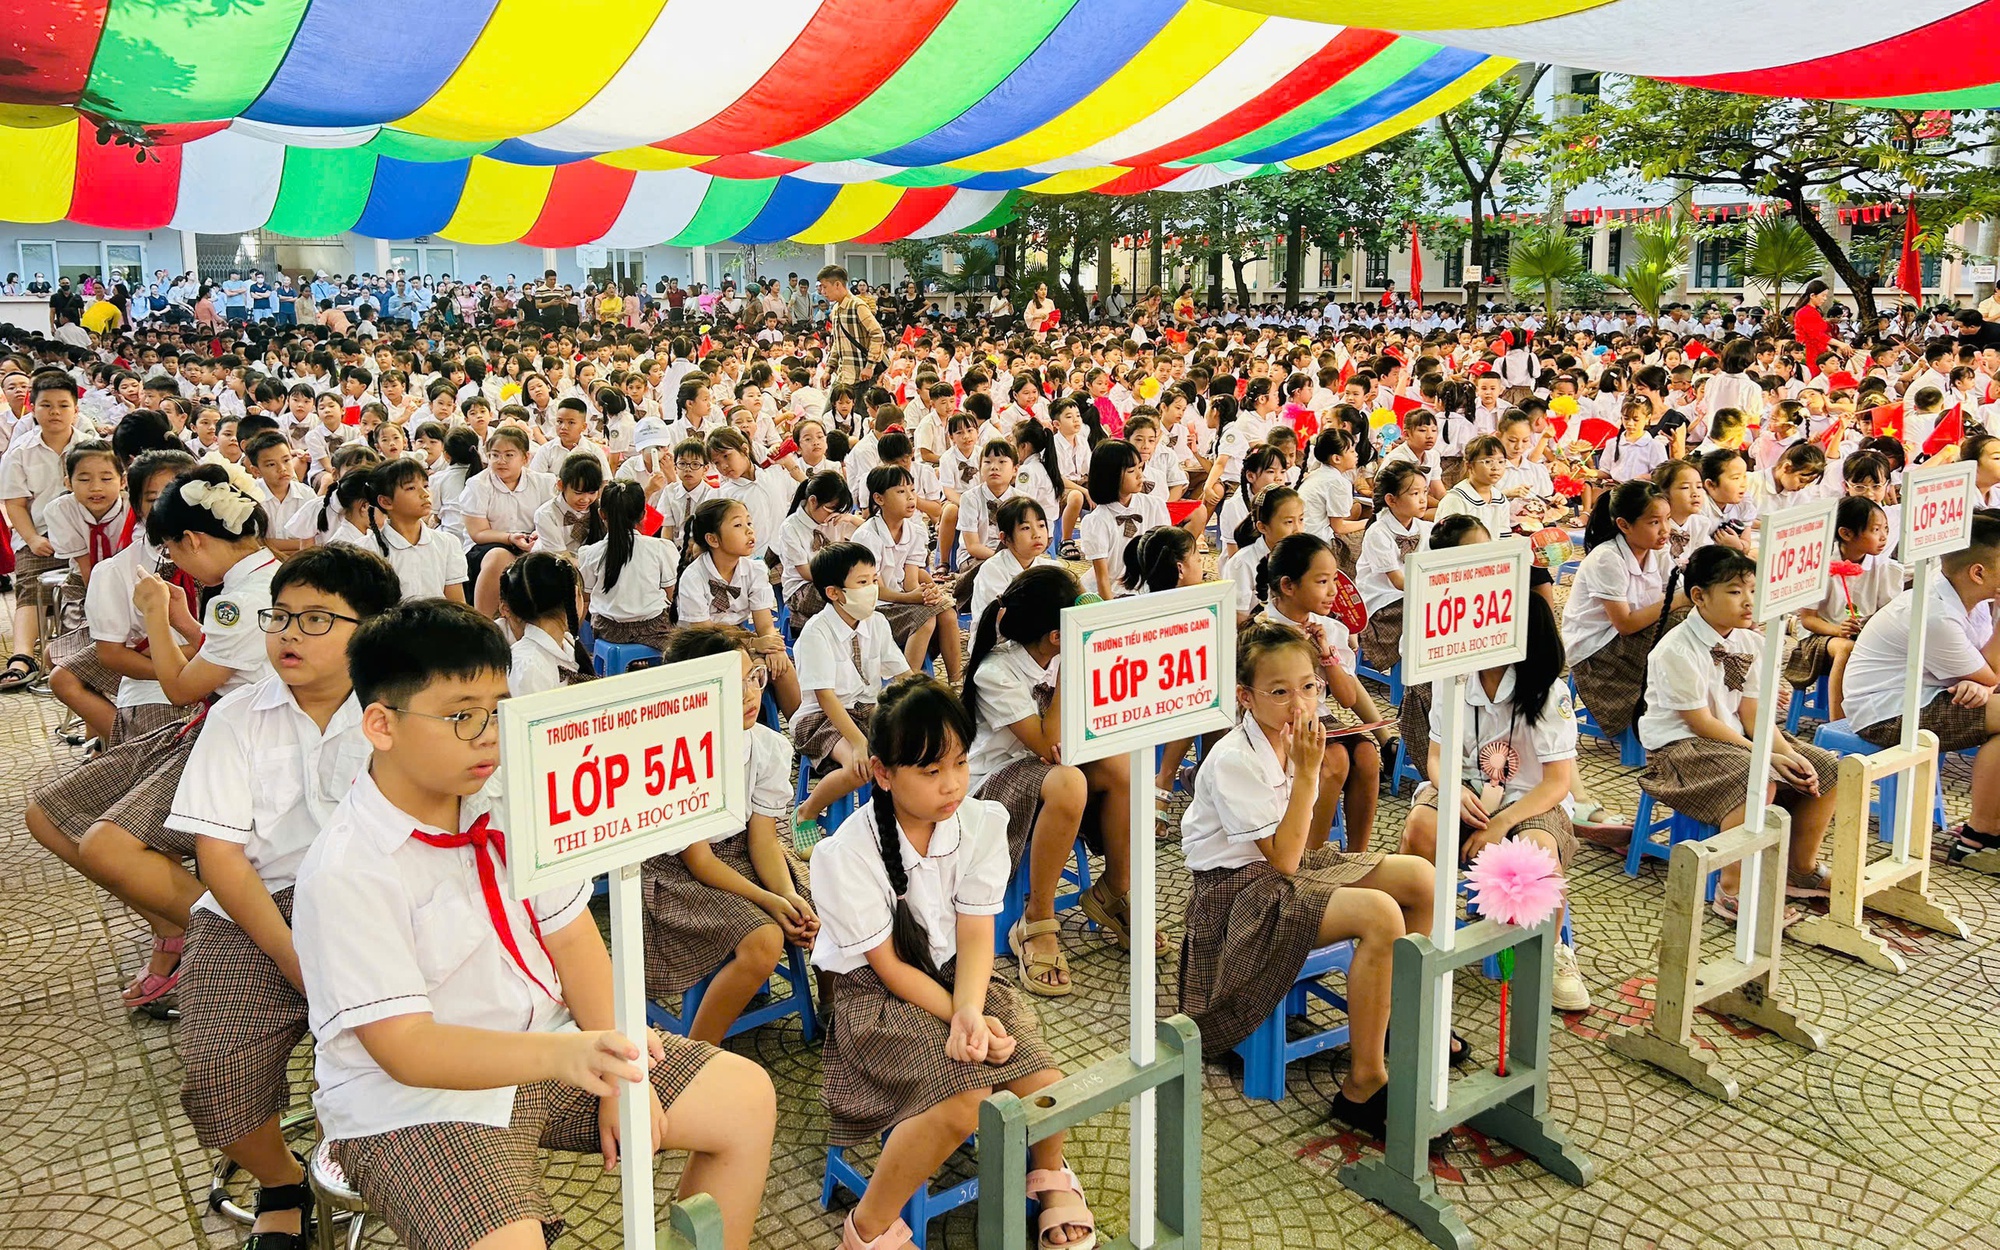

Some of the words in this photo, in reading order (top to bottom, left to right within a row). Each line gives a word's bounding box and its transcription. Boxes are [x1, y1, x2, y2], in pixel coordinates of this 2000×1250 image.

[1914, 496, 1937, 531] LỚP
[1940, 497, 1963, 525] 3A4
[1770, 540, 1795, 583] LỚP
[1797, 541, 1822, 574] 3A3
[1092, 637, 1123, 653] TRƯỜNG
[1124, 630, 1141, 646] TIỂU
[1143, 629, 1158, 644] HỌC
[1159, 623, 1189, 639] PHƯƠNG
[1190, 618, 1210, 632] CANH
[1425, 588, 1466, 638] LỚP
[1473, 589, 1512, 629] 3A2
[1428, 647, 1444, 660] THI
[1446, 641, 1467, 656] ĐUA
[1469, 635, 1489, 653] HỌC
[1490, 628, 1508, 646] TỐT
[1092, 655, 1148, 707] LỚP
[1158, 645, 1207, 690] 3A1
[547, 720, 589, 745] TRƯỜNG
[592, 709, 614, 733] TIỂU
[617, 708, 638, 729] HỌC
[640, 699, 680, 722] PHƯƠNG
[682, 691, 708, 711] CANH
[1092, 713, 1118, 730] THI
[1122, 706, 1152, 724] ĐUA
[1155, 698, 1184, 715] HỌC
[1187, 685, 1213, 707] TỐT
[546, 744, 630, 826] LỚP
[644, 731, 714, 796] 5A1
[554, 831, 587, 855] THI
[593, 819, 632, 844] ĐUA
[637, 803, 674, 829] HỌC
[677, 787, 709, 816] TỐT
